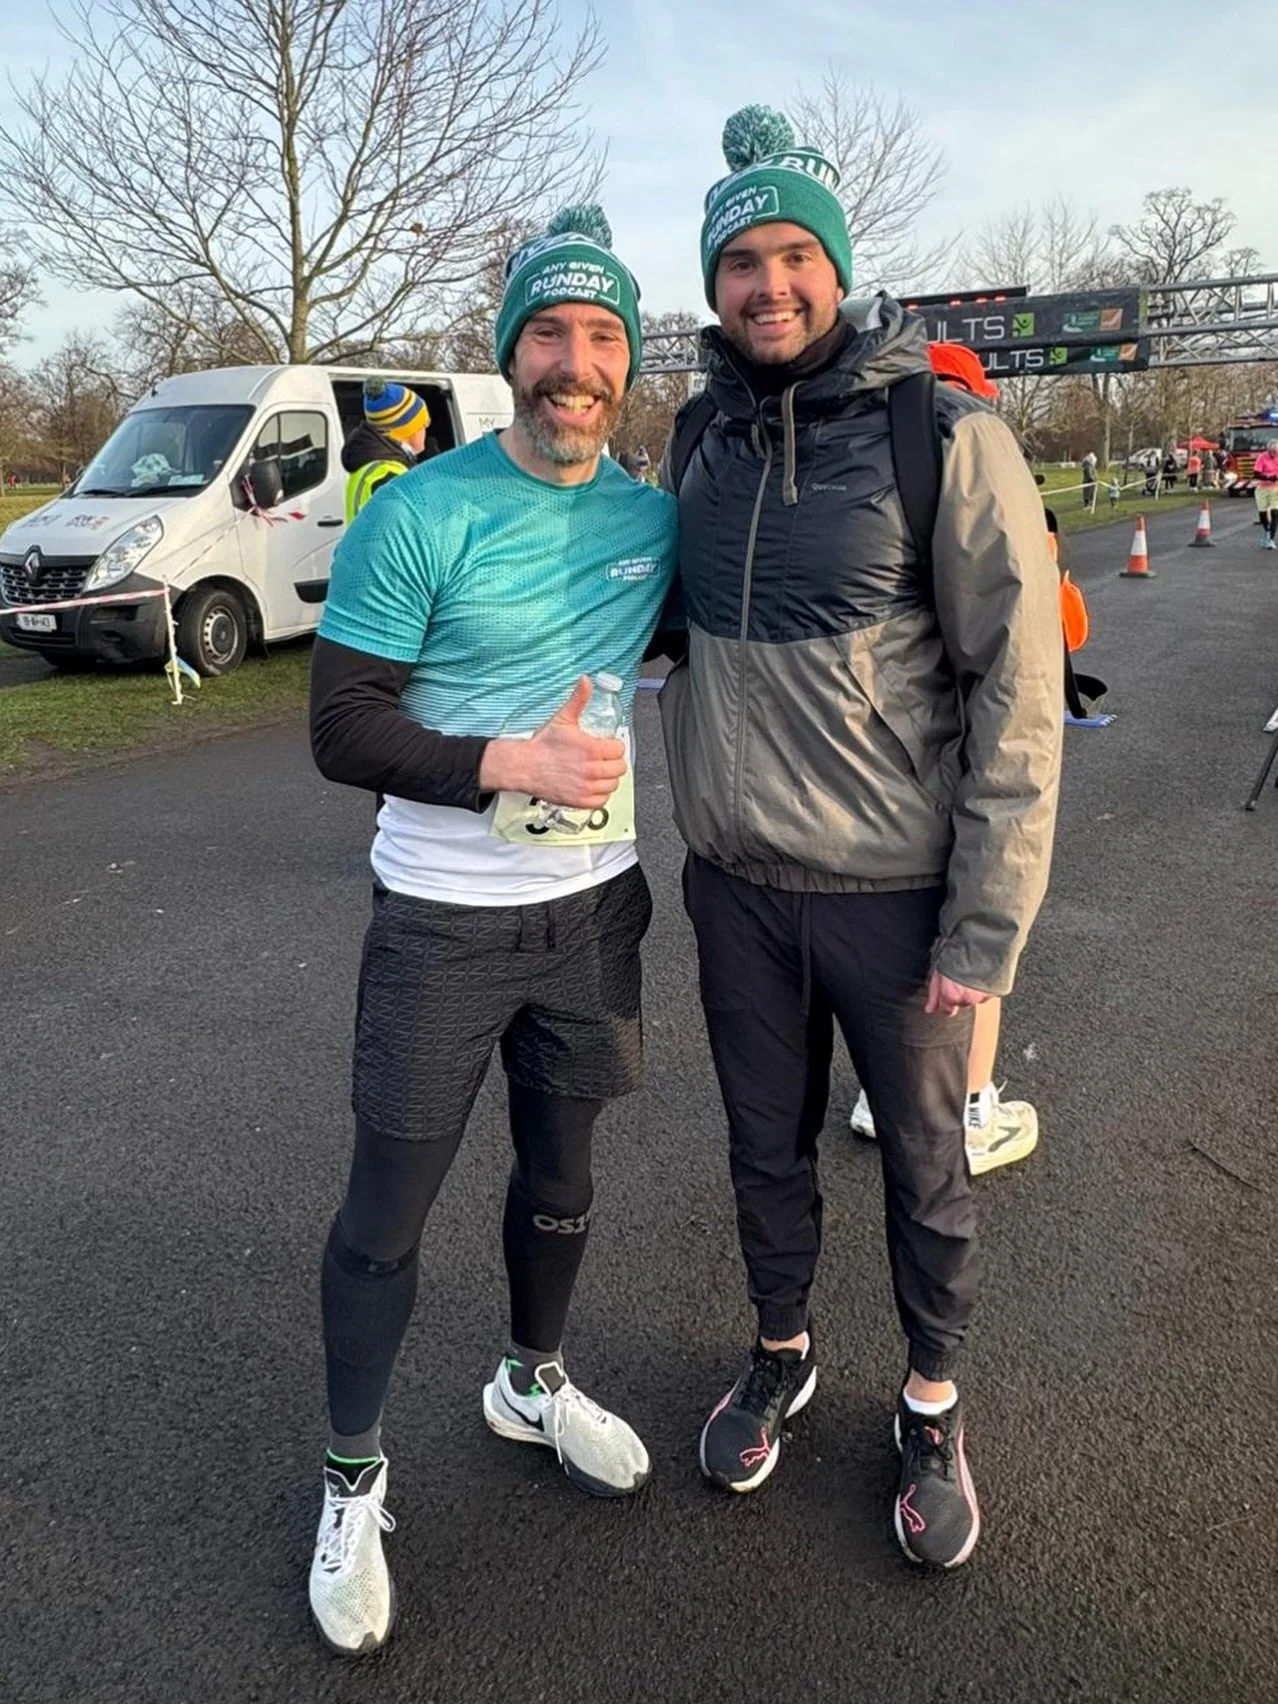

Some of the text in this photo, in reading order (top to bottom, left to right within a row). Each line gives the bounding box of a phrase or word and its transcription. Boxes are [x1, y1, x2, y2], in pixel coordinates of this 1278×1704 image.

[541, 261, 605, 275] ANY GIVEN
[530, 272, 615, 297] RUNDAY
[543, 287, 598, 300] PODCAST
